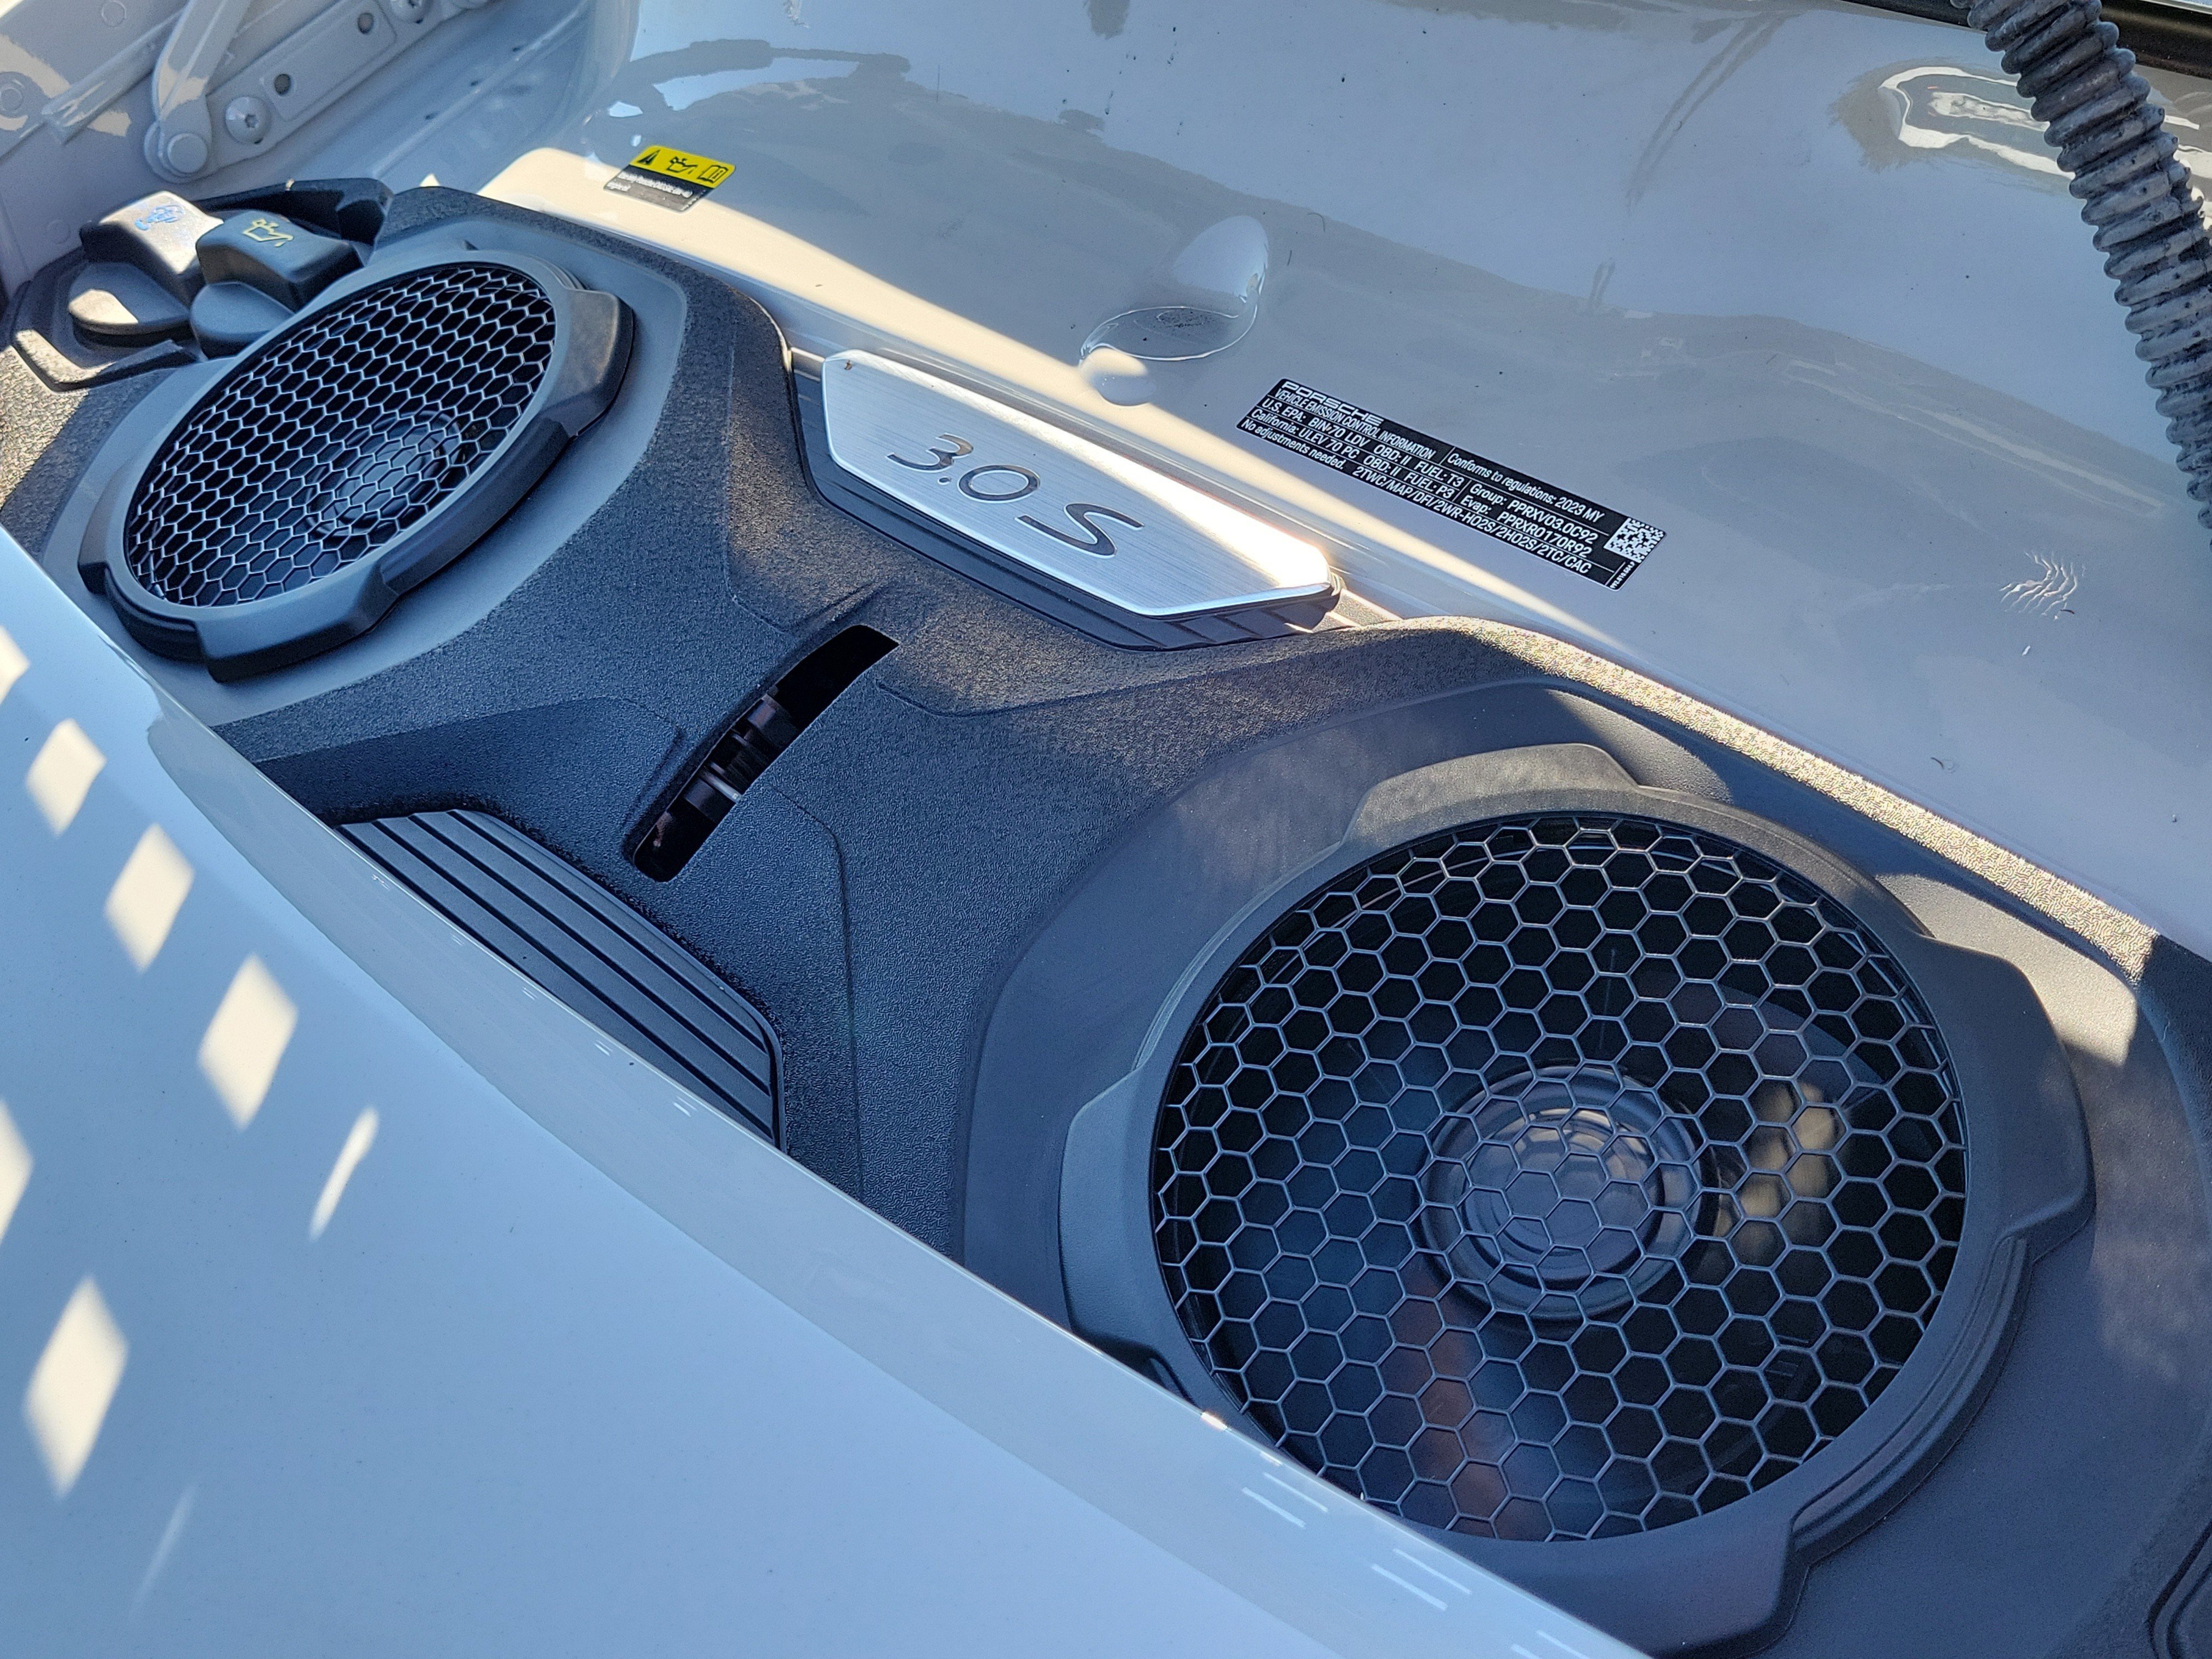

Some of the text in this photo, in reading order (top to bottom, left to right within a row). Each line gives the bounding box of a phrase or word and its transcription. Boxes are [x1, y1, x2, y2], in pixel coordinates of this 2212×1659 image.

[1275, 388, 1436, 460] VEHICLE EMISSION CONTROL INFORMATION
[1282, 381, 1384, 426] PORSCHE
[1241, 419, 1257, 431] No
[1255, 426, 1311, 454] adjustments
[1308, 449, 1346, 470] needed.
[1251, 409, 1299, 434] California:
[1299, 427, 1329, 445] ULEV
[1325, 439, 1343, 452] 70
[1341, 445, 1360, 459] PC
[1363, 455, 1391, 473] OBD:
[1403, 472, 1437, 492] FUEL:
[1435, 484, 1455, 499] P3
[1262, 398, 1282, 413] U.S.
[1282, 406, 1306, 422] EPA:
[1308, 417, 1329, 431] BIN
[1328, 425, 1346, 438] 70
[1345, 432, 1370, 447] LDV
[1373, 444, 1402, 462] OBD:
[1414, 461, 1447, 481] FUEL:
[1447, 473, 1464, 487] T3
[885, 433, 1144, 559] 3.0 S
[1447, 453, 1605, 522] Conforms to regulations: 2023 MY
[1460, 494, 1492, 515] Evap:
[1470, 483, 1598, 544] Group: PPRXV03.0C92
